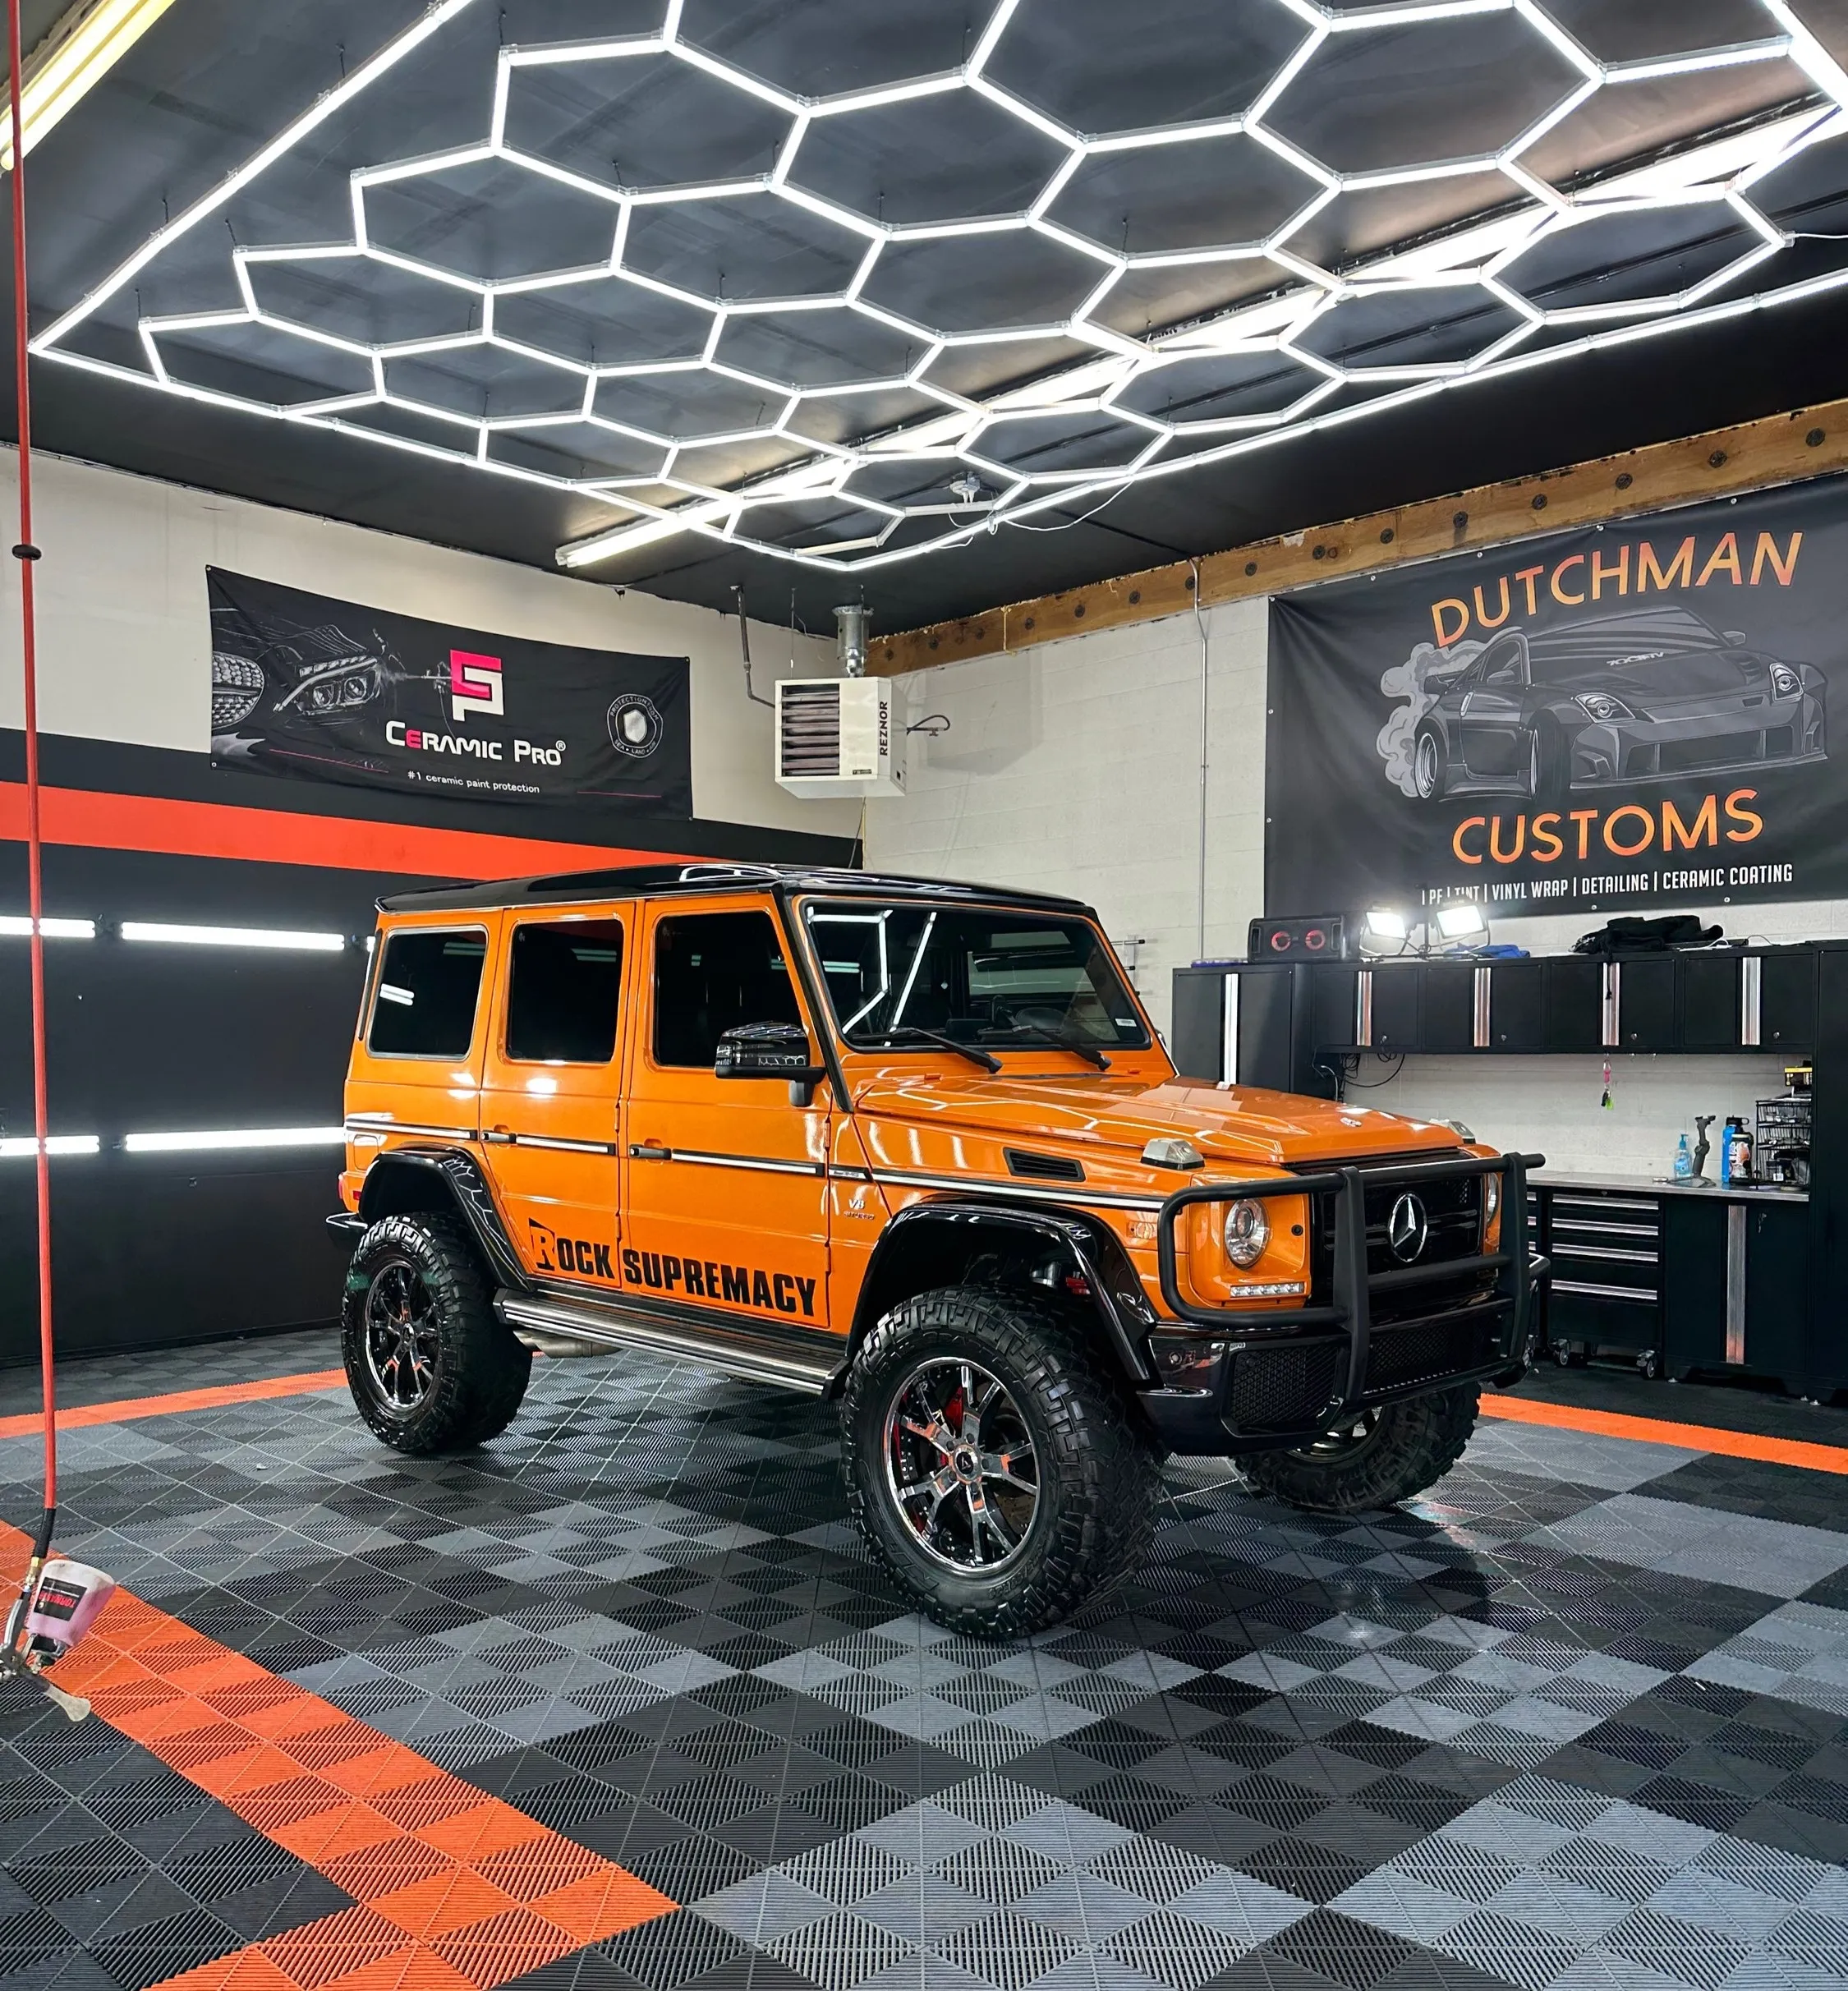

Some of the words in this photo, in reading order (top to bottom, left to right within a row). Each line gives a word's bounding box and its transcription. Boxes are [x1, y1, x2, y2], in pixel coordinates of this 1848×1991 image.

[1431, 531, 1803, 647] DUTCHMAN
[385, 720, 503, 761] CERAMIC
[879, 701, 888, 756] REZNOR
[407, 770, 422, 780] #1
[425, 774, 464, 786] ceramic
[466, 779, 490, 789] paint
[493, 782, 540, 794] protection
[1451, 788, 1764, 864] CUSTOMS
[1492, 882, 1528, 901] VINYL
[1531, 879, 1568, 899] WRAP
[1581, 873, 1648, 895] DETAILING
[1662, 867, 1725, 890] CERAMIC
[1729, 863, 1793, 885] COATING
[528, 1218, 614, 1280] ROCK
[622, 1248, 816, 1317] SUPREMACY
